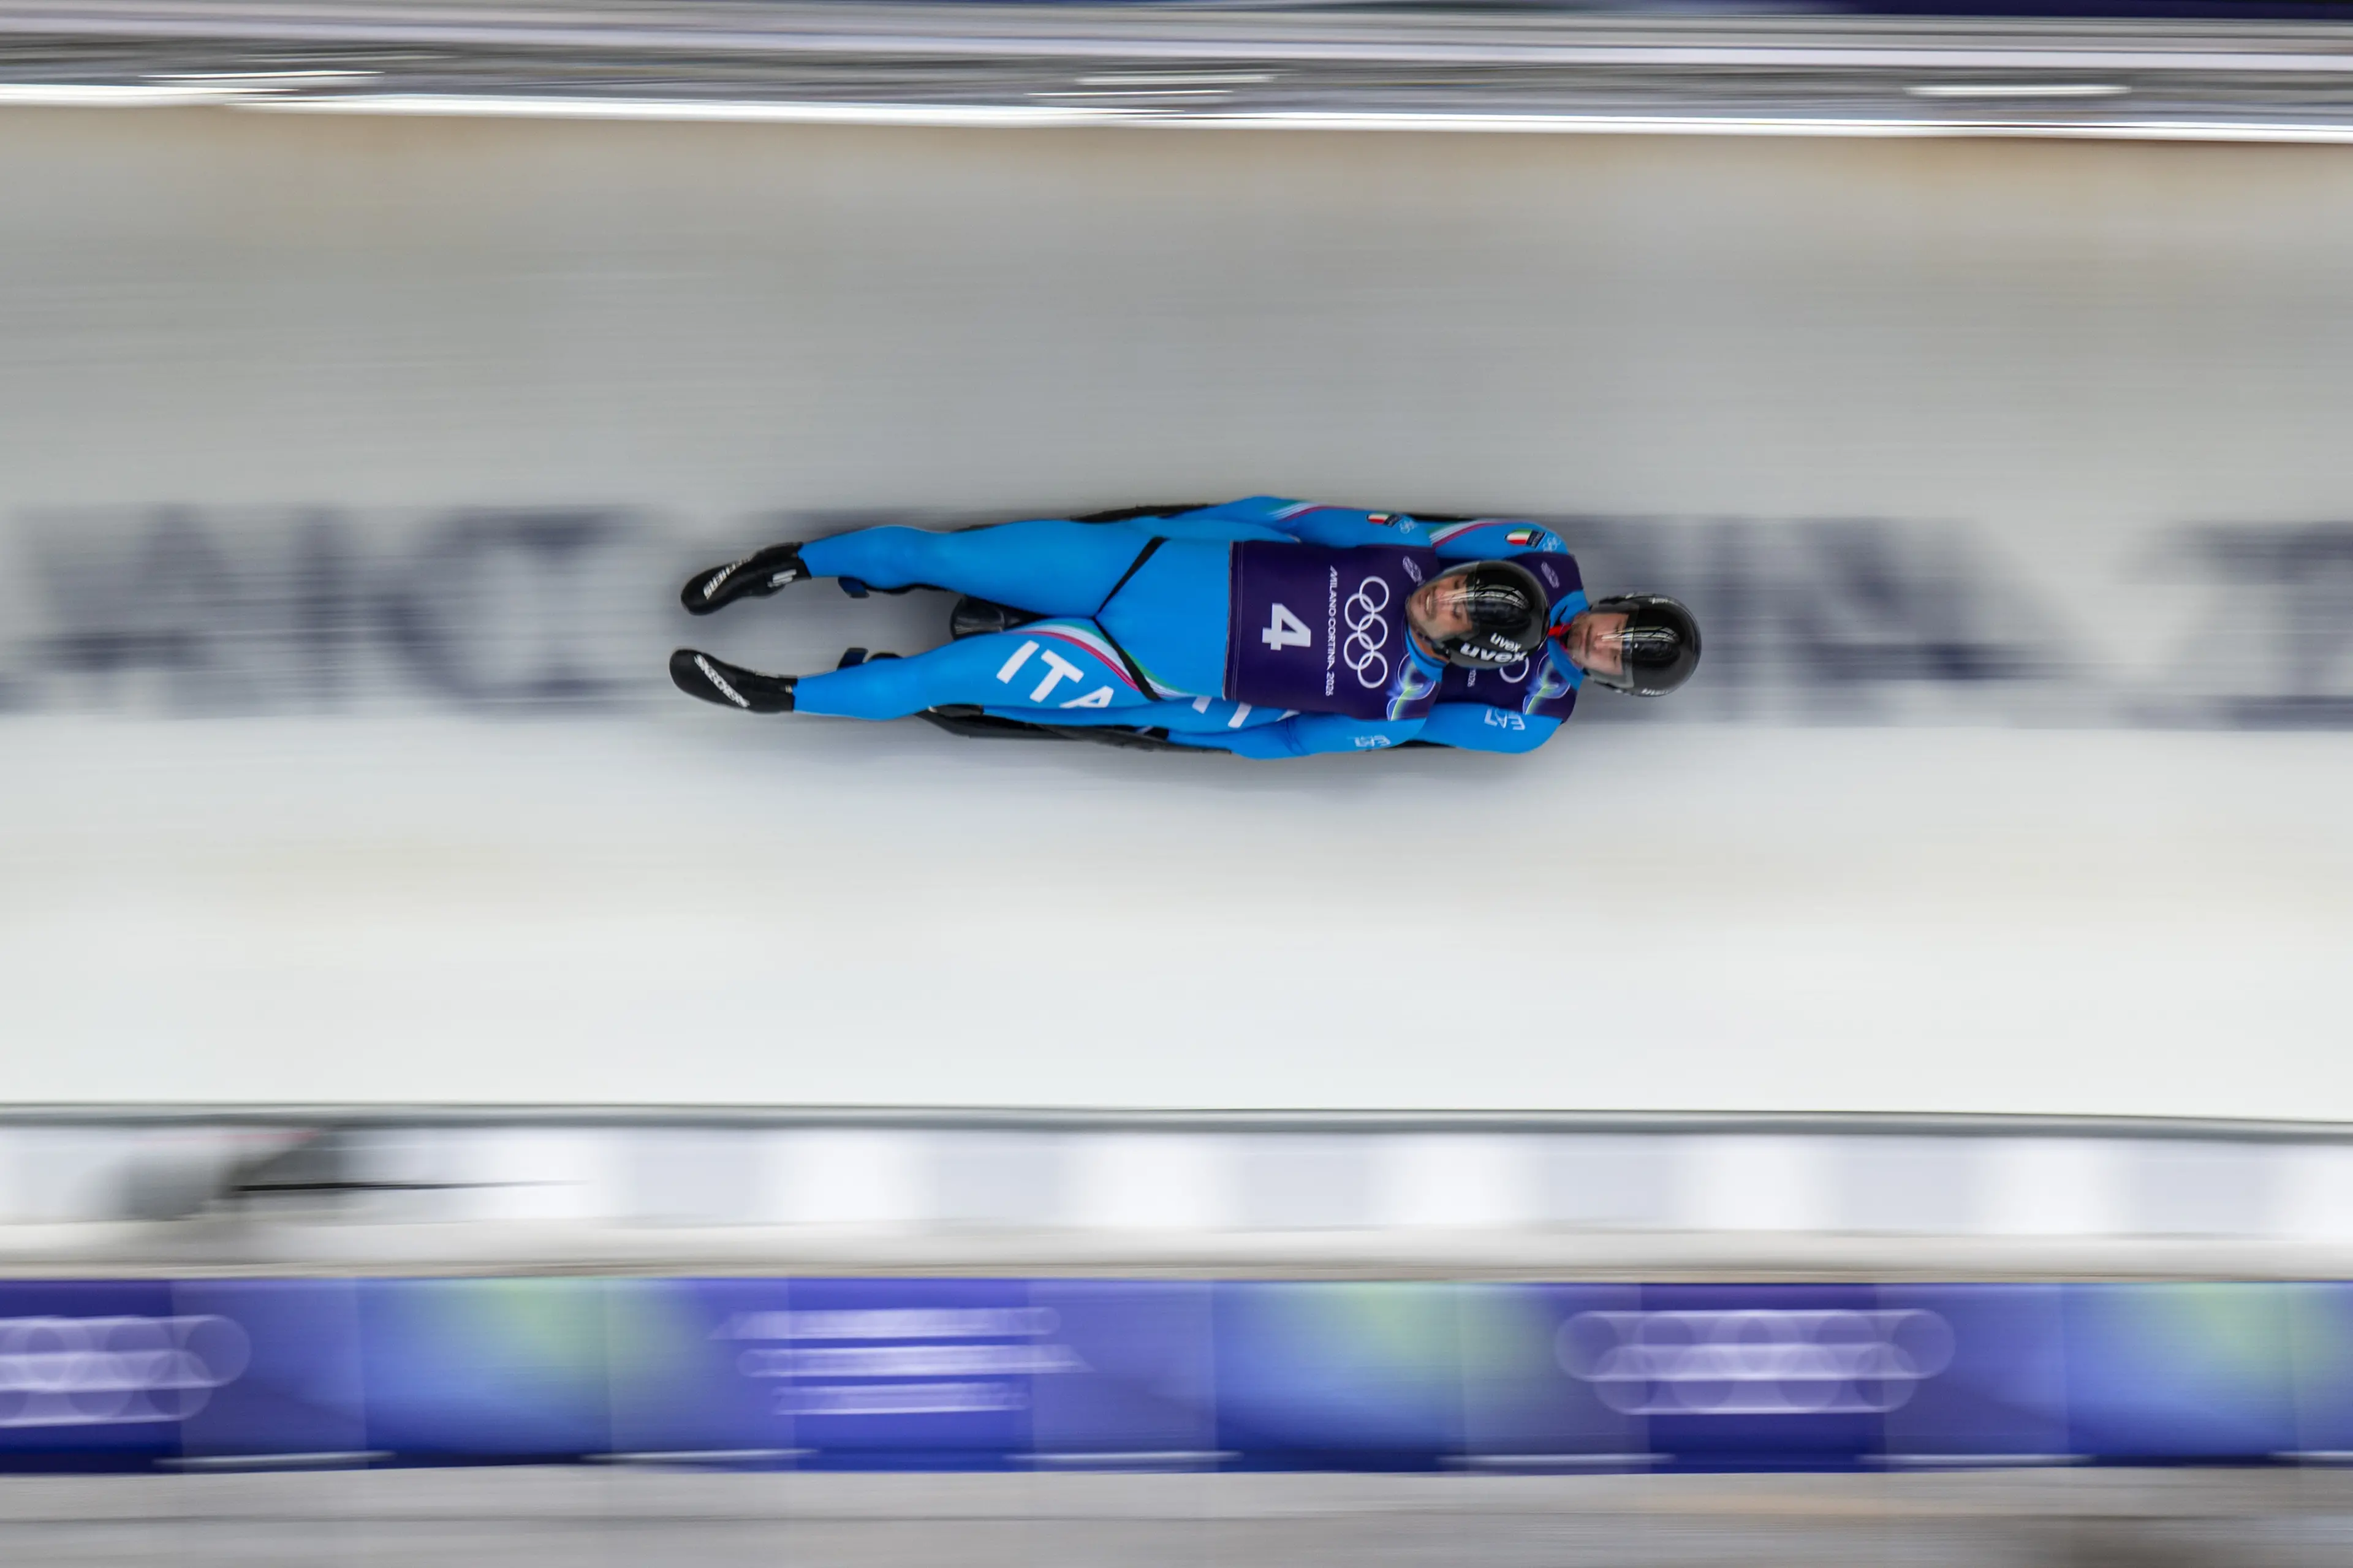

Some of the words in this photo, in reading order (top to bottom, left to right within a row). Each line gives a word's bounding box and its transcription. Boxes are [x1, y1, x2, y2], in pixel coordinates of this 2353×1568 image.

[1328, 565, 1338, 616] MILANO
[1262, 603, 1312, 651] 4
[1327, 617, 1336, 670] CORTINA
[1490, 632, 1521, 653] uvex
[1460, 643, 1528, 663] uvex
[1325, 672, 1335, 696] 2026
